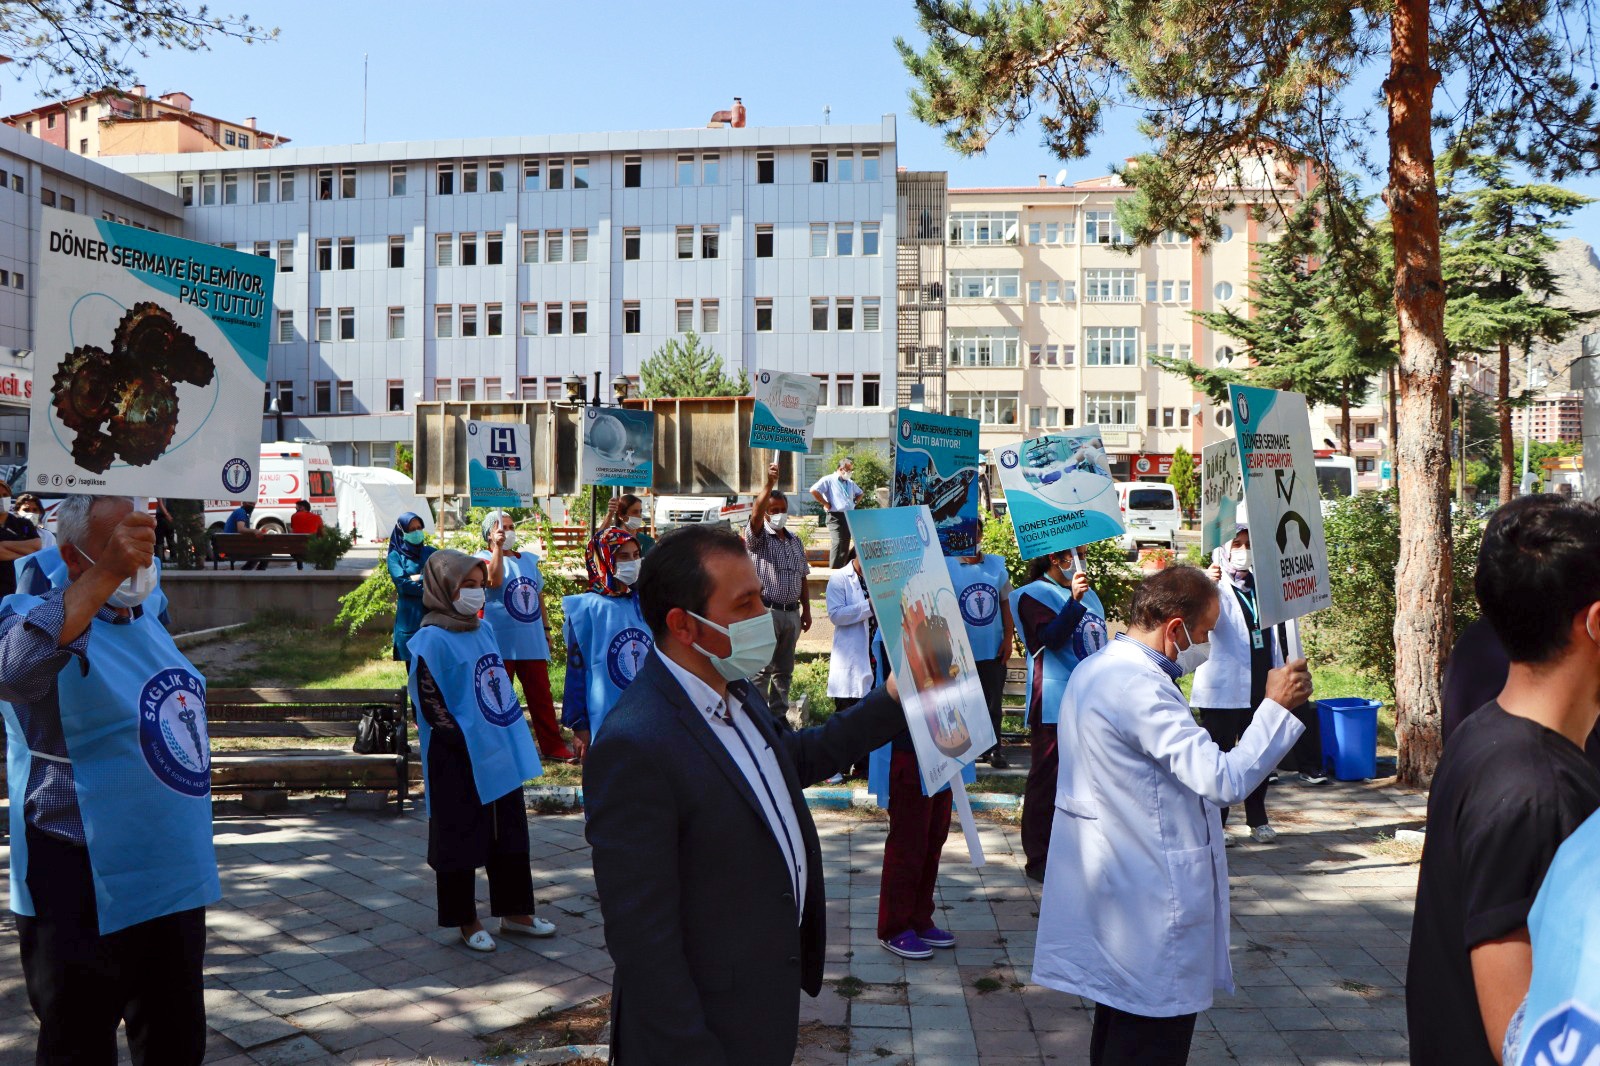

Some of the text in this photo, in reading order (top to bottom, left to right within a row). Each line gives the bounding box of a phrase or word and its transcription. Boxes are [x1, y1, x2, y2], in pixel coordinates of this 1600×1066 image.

[50, 228, 266, 298] DÖNER SERMAYE İŞLEMİYOR,
[179, 285, 265, 320] PAS TUTTU!
[0, 372, 22, 397] CİL
[754, 424, 806, 436] DÖNER SERMAYE
[912, 434, 961, 449] BATTI BATIYOR!
[929, 425, 952, 436] SERMAYE
[1242, 429, 1291, 450] DÖNER SERMAYE
[1018, 509, 1085, 534] DÖNER SERMAYE
[1020, 519, 1089, 544] YOĞUN BAKIMDA!
[861, 537, 884, 560] DÖNER
[1280, 553, 1315, 578] BEN SANA
[1283, 573, 1318, 602] DÖNERİM!
[611, 631, 652, 654] SAĞLIK SE
[145, 674, 184, 722] SAĞLIK
